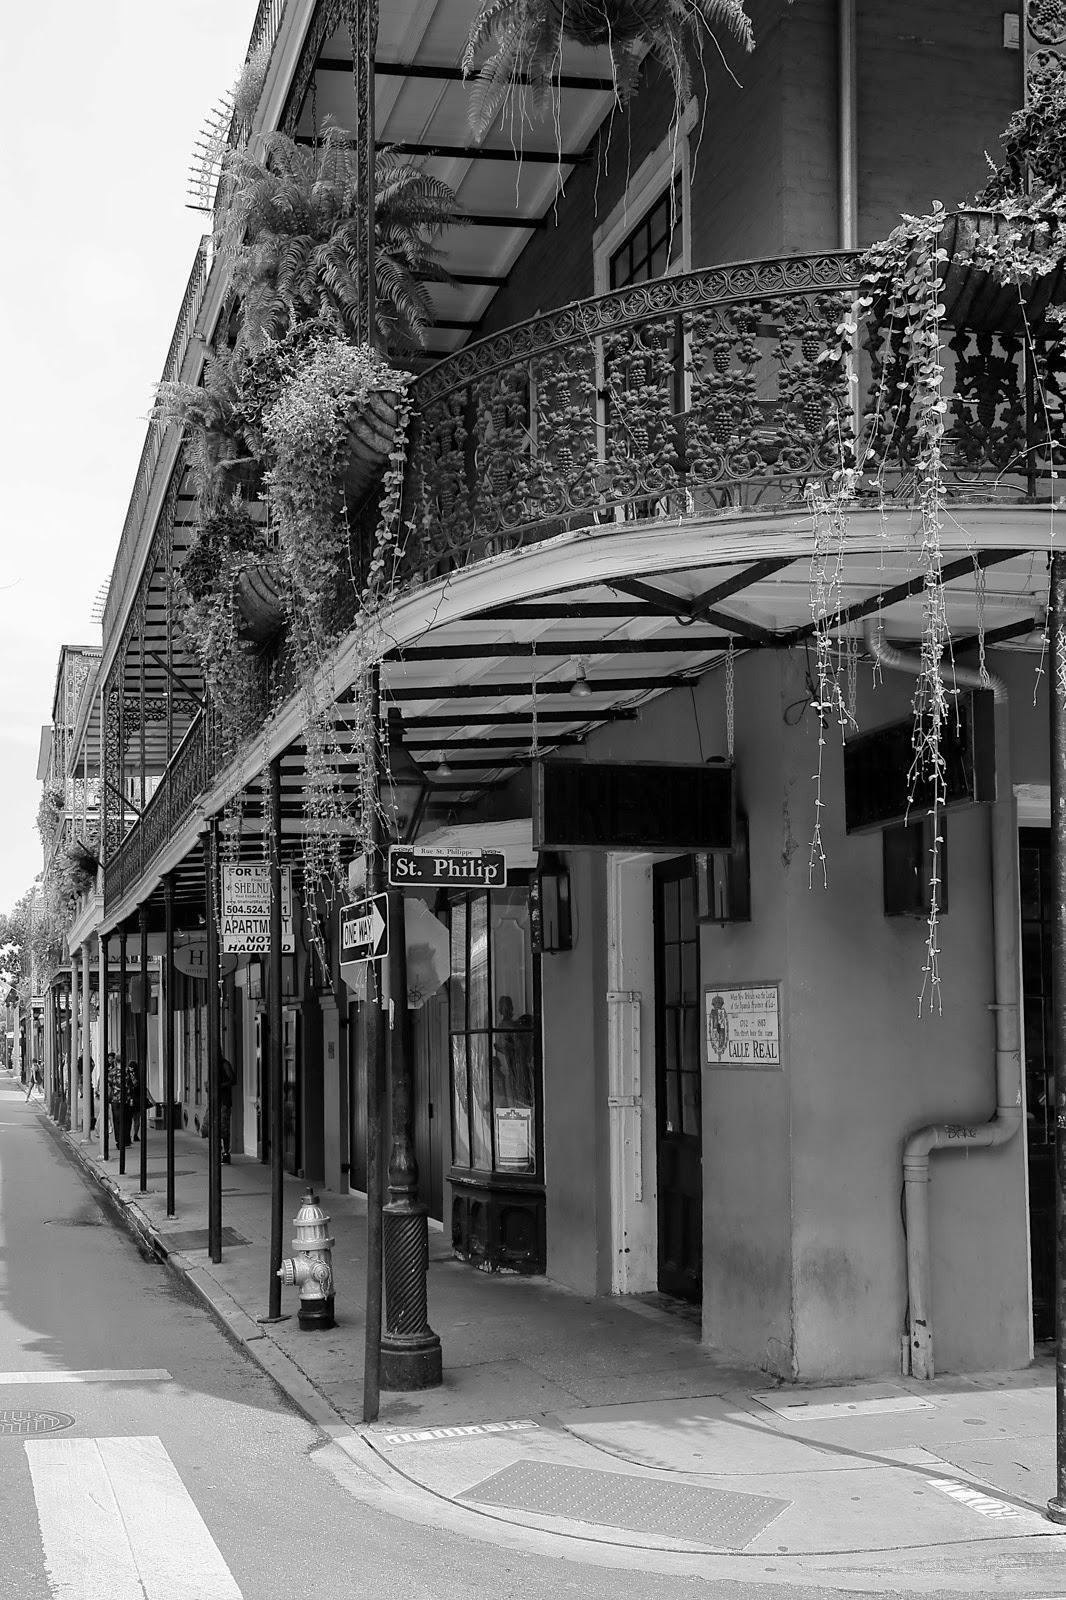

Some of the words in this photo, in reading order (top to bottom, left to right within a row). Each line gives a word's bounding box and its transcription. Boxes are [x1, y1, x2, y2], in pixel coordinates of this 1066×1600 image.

[420, 848, 434, 856] Rue
[436, 848, 445, 856] St.
[447, 848, 474, 857] Philippe
[229, 868, 252, 876] FOR
[255, 868, 287, 877] LEE
[396, 858, 423, 876] St.
[433, 859, 498, 884] Philip
[234, 882, 269, 894] SHELNU
[226, 905, 287, 914] 504.524.11
[224, 919, 289, 934] APARTMT
[344, 922, 357, 946] ONE
[358, 917, 373, 942] WAY
[228, 944, 291, 952] HAUNTD
[729, 1040, 749, 1057] CALLE
[753, 1040, 777, 1058] REAL
[390, 1425, 487, 1443] PHILIP
